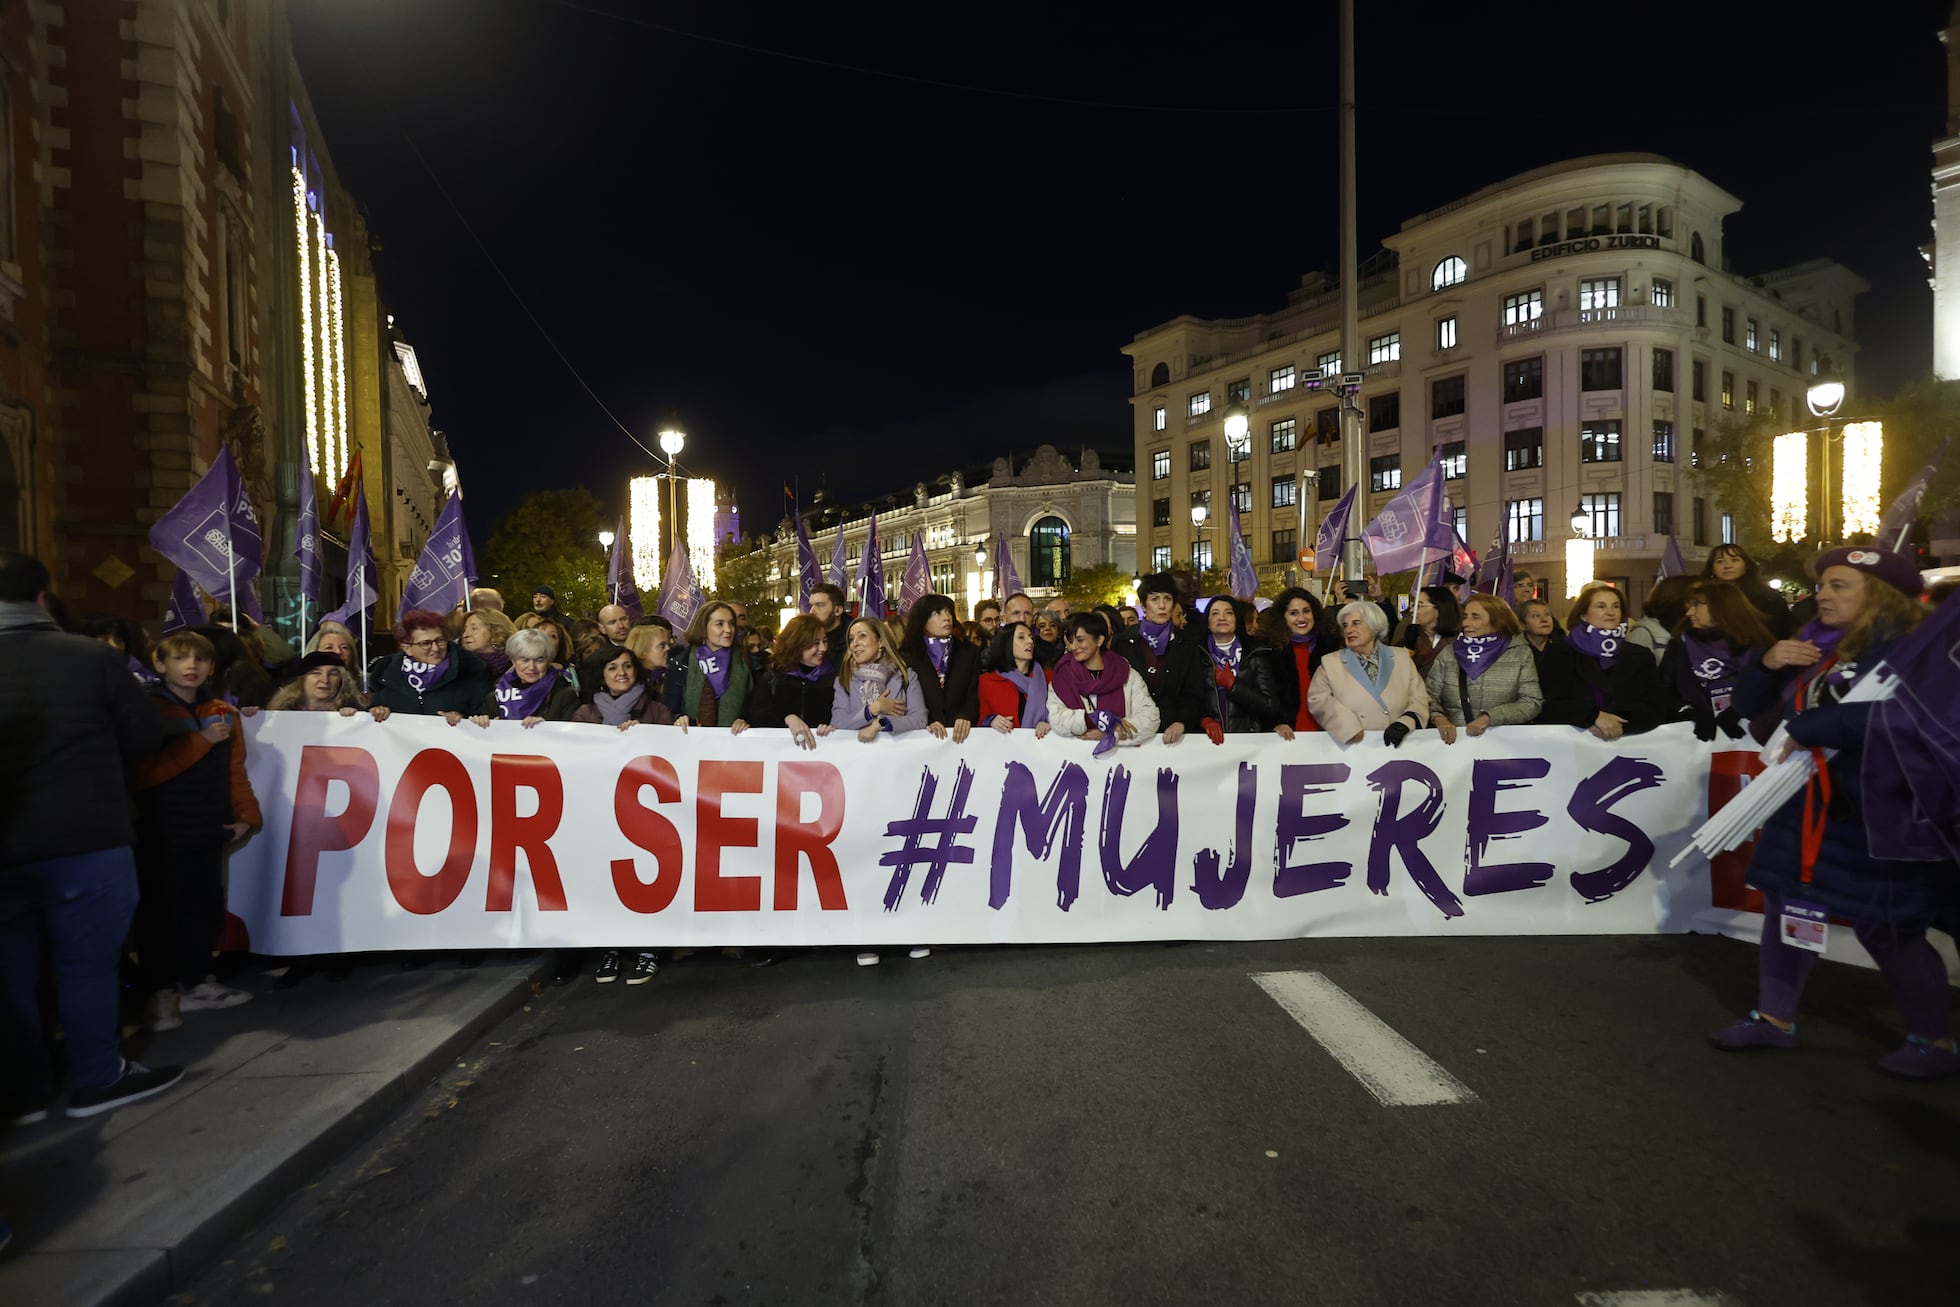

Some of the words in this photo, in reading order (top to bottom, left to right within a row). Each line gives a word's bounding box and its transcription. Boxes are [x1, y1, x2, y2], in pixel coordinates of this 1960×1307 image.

[1531, 238, 1600, 261] EDIFICIO
[1607, 235, 1661, 250] ZURICH
[281, 744, 568, 915] POR
[610, 754, 848, 914] SER
[878, 755, 1667, 919] #MUJERES
